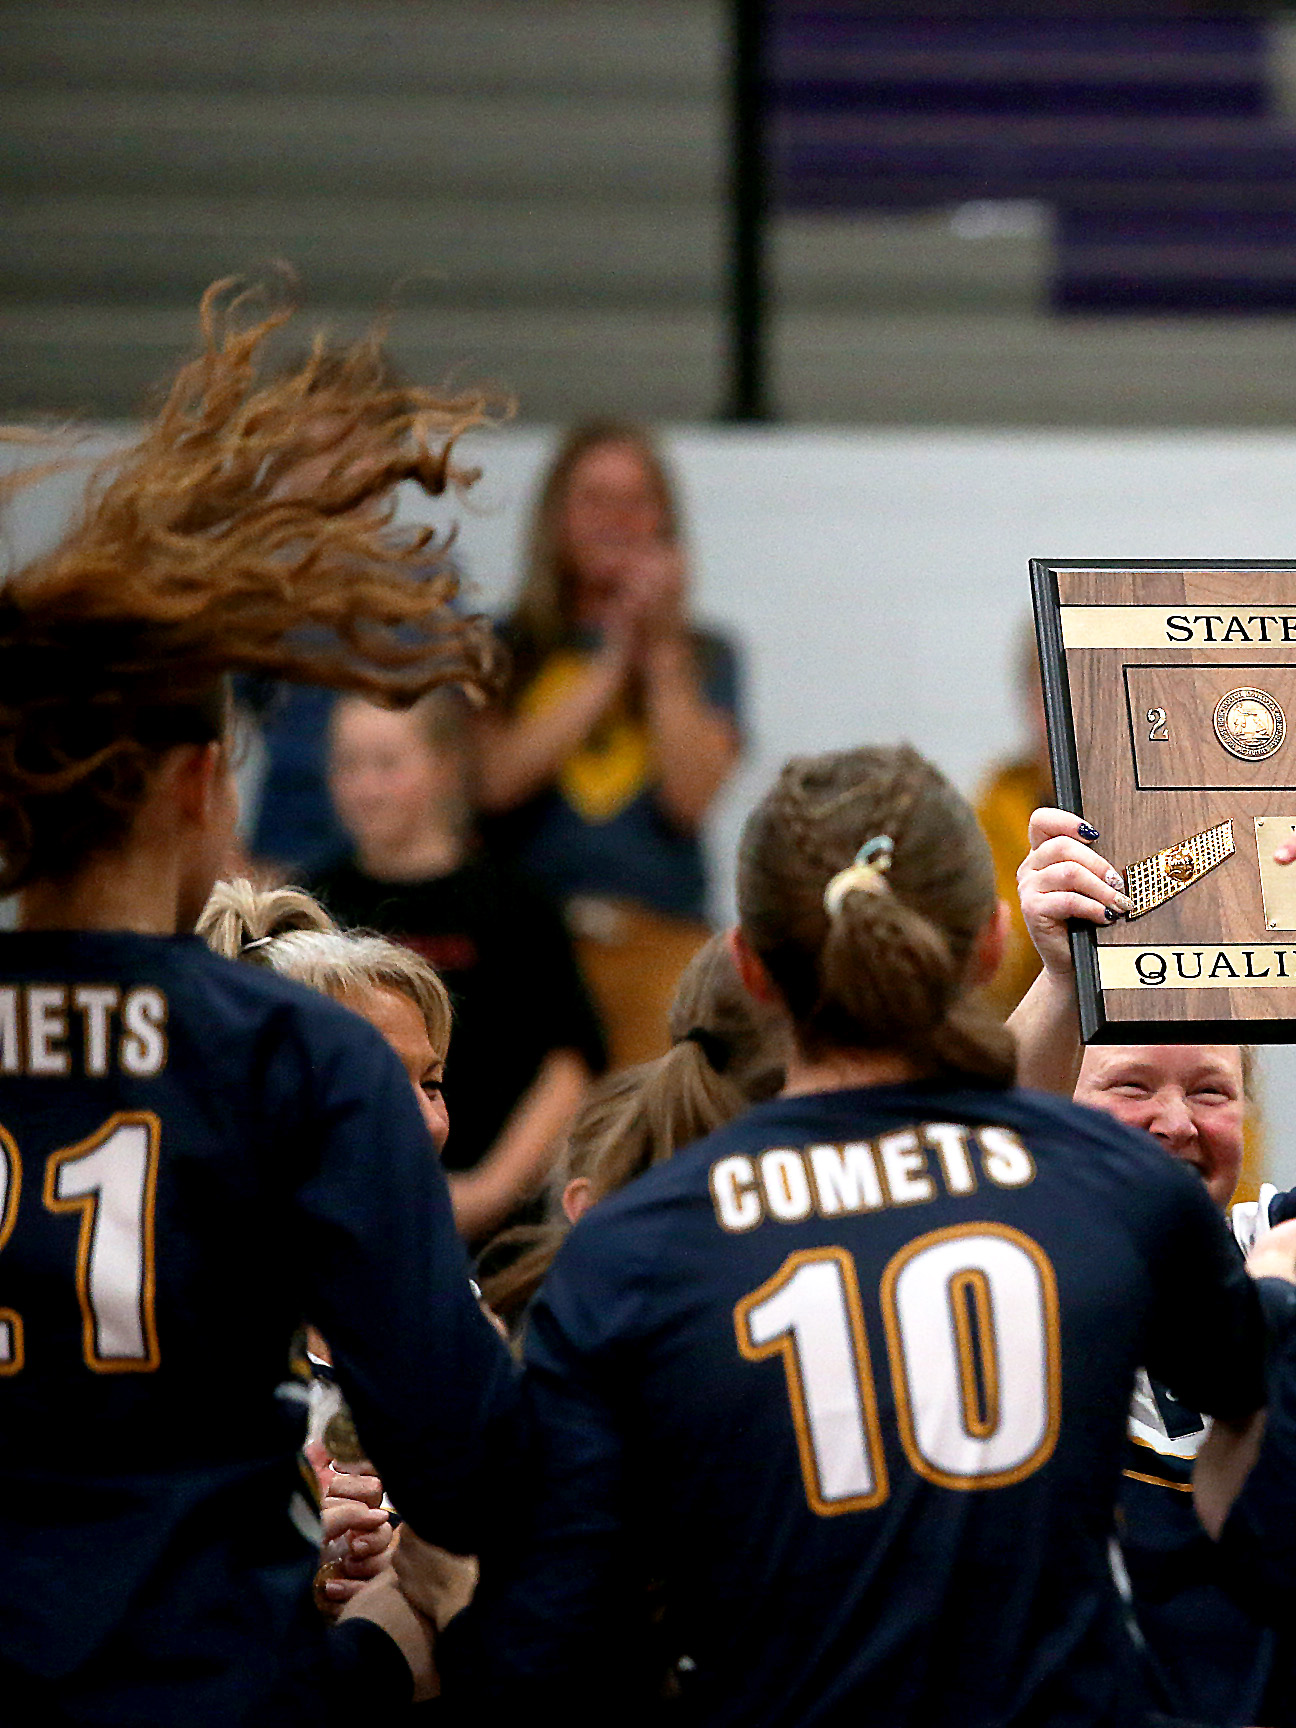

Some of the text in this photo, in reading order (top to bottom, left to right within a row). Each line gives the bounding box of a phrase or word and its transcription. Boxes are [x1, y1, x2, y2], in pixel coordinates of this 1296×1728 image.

[1146, 706, 1170, 741] 2
[0, 1110, 162, 1376] 1
[708, 1122, 1037, 1234] COMETS
[733, 1220, 1063, 1517] 10
